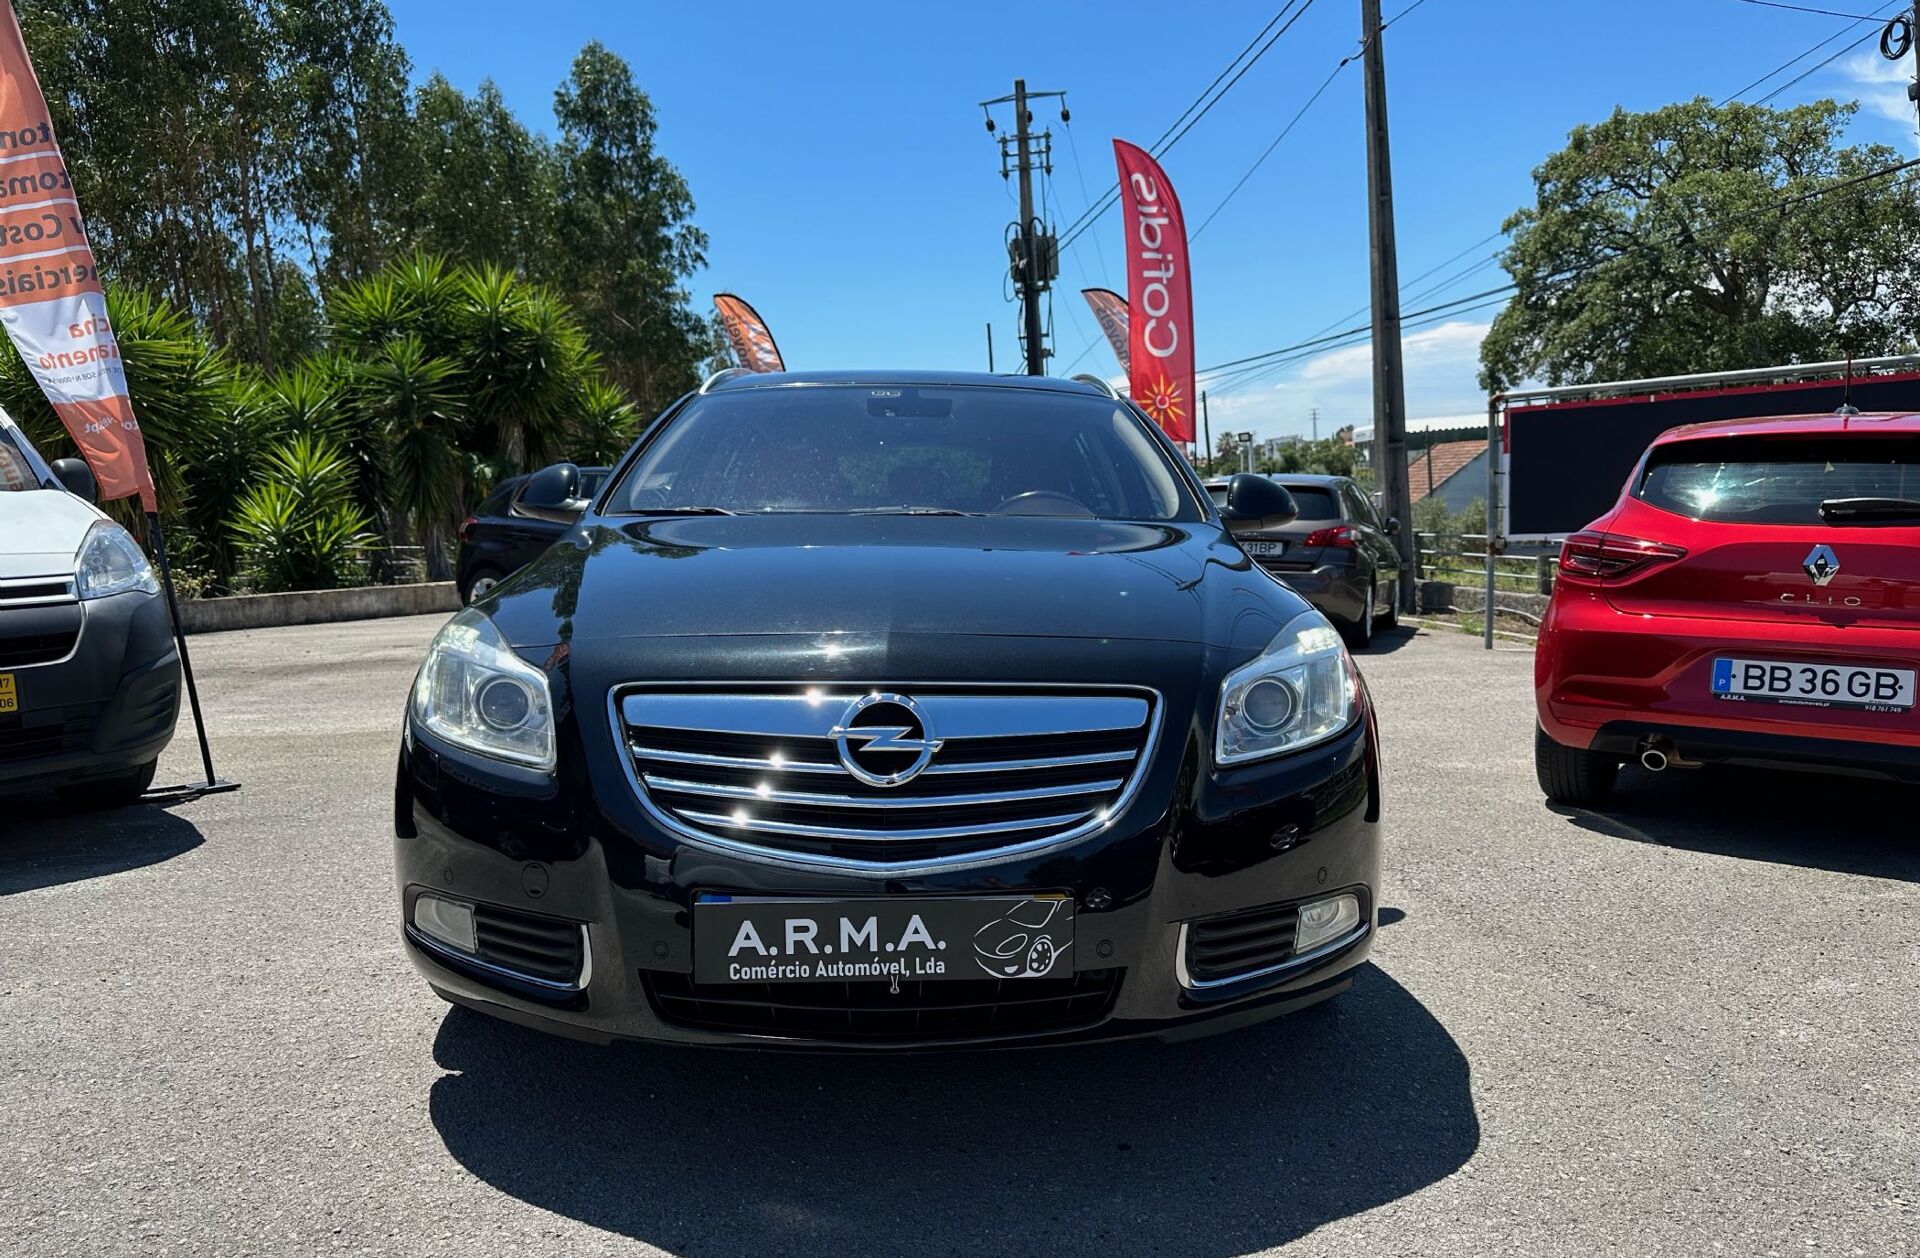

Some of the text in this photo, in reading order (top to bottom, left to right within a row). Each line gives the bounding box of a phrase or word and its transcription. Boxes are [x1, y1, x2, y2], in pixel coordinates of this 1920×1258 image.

[1780, 593, 1861, 606] CLIO
[727, 914, 947, 957] A.R.M.A.
[729, 956, 945, 981] Comércio Automóvel, Lda
